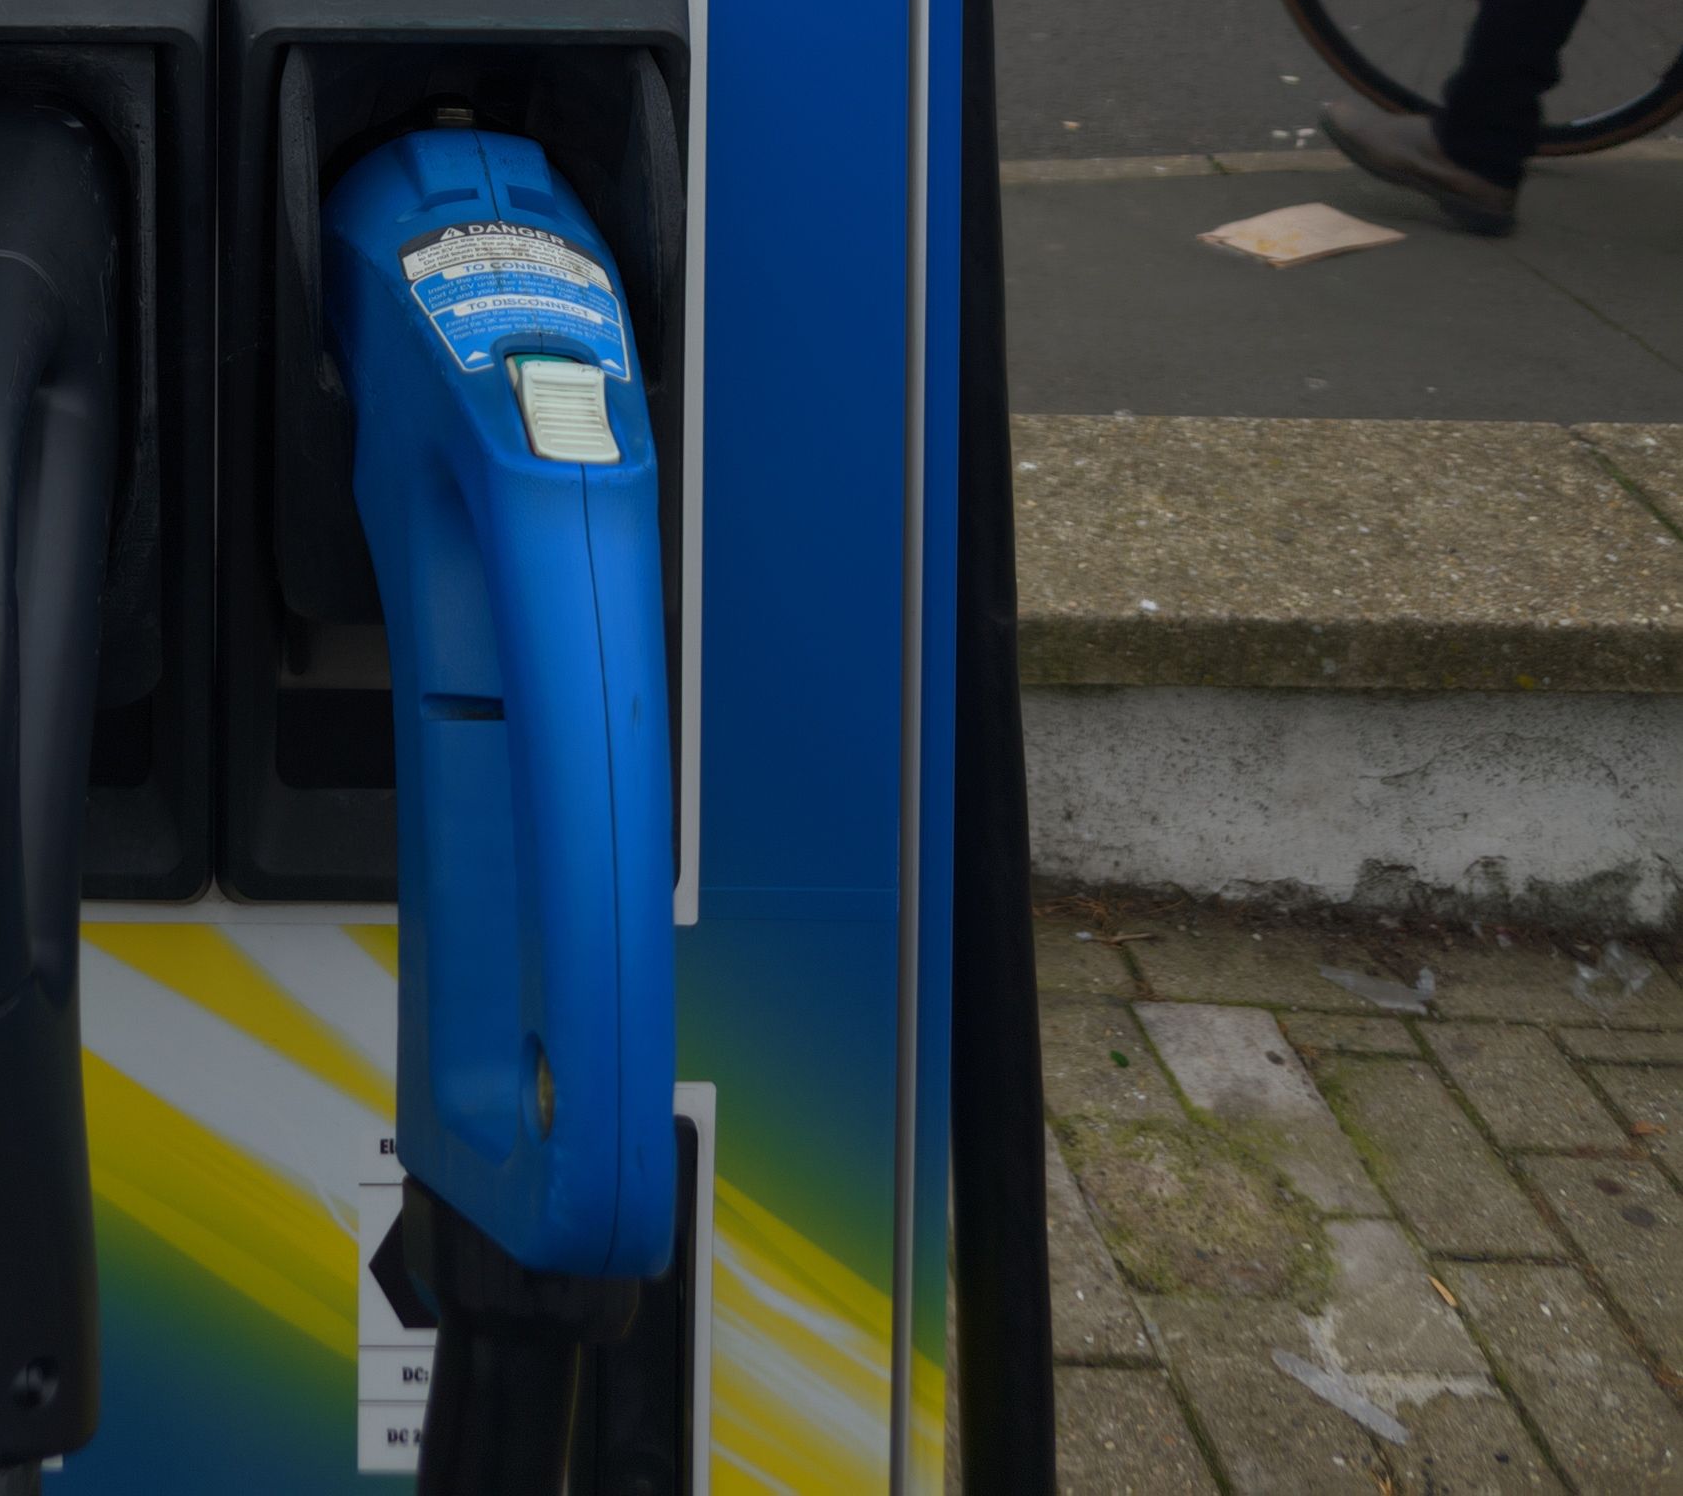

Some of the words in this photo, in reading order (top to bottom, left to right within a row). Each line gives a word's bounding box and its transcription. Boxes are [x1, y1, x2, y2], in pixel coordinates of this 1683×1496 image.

[467, 224, 566, 247] DANGER
[464, 262, 485, 273] TO
[490, 261, 570, 279] CONNECT
[467, 299, 488, 311] TO
[493, 298, 590, 318] DISCONNECT
